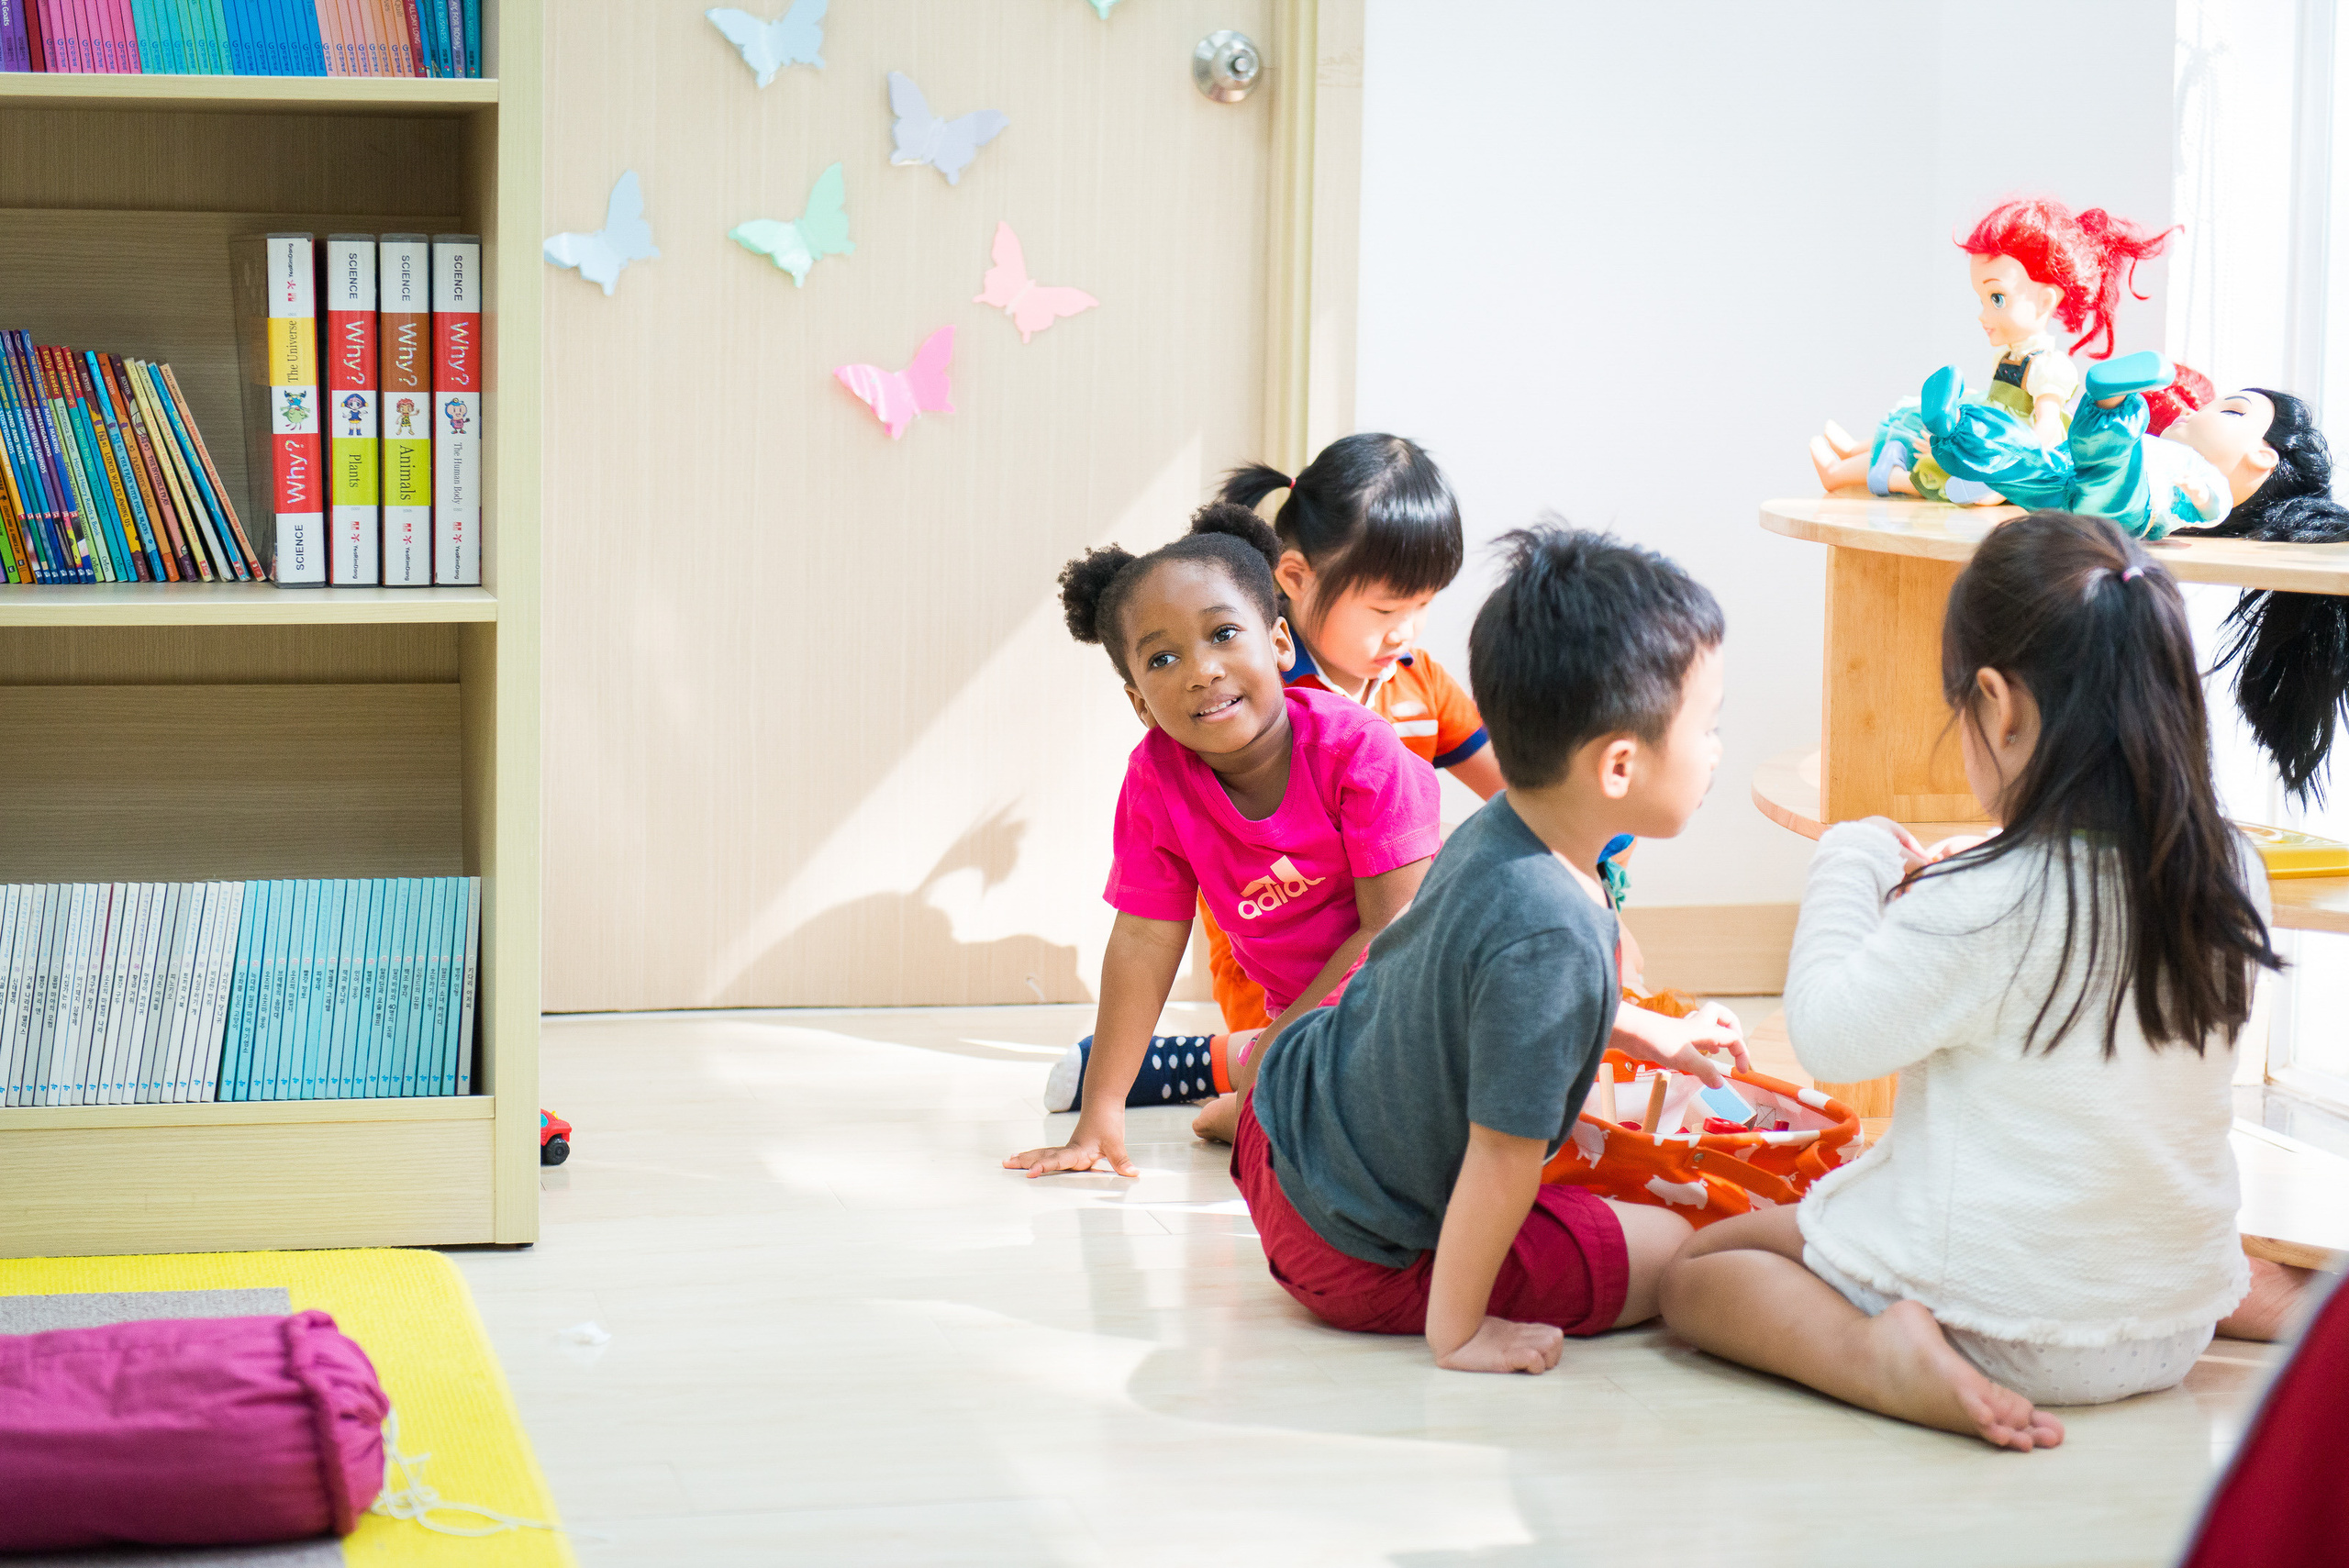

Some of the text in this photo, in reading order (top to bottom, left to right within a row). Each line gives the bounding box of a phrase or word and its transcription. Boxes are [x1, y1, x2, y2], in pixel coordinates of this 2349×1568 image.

[410, 15, 418, 27] DAY
[439, 13, 448, 44] BUSINESS
[413, 28, 421, 44] LONG
[349, 252, 358, 300] SCIENCE
[401, 255, 411, 302] SCIENCE
[454, 255, 463, 302] SCIENCE
[287, 320, 297, 362] Universe
[343, 320, 365, 385] Why?
[395, 322, 417, 386] Why?
[448, 322, 470, 386] Why?
[66, 352, 74, 368] Early
[72, 370, 81, 391] Reader
[82, 373, 92, 392] BENTON
[121, 376, 131, 395] BENTON
[287, 365, 299, 384] The
[13, 367, 21, 383] LITTLE
[25, 409, 33, 430] GAMES
[37, 449, 47, 473] SOUNDS
[35, 408, 52, 457] INVESTIGATIONS
[44, 407, 53, 427] MARK
[50, 428, 61, 454] MAKING
[6, 410, 15, 428] SAND
[11, 428, 19, 442] AND
[16, 444, 26, 465] WATER
[17, 409, 30, 444] PARACHUTE
[27, 445, 35, 461] PLAY
[106, 376, 116, 395] BENTON
[131, 456, 146, 488] FRANTASTIC
[141, 488, 153, 509] VOYAGE
[42, 350, 51, 368] Early
[49, 371, 60, 395] Reader
[59, 406, 70, 434] Francesca
[67, 434, 75, 452] Simon
[72, 458, 83, 478] Horrid
[78, 478, 90, 497] Henry
[84, 497, 95, 516] Reads
[92, 521, 101, 537] Book
[101, 555, 111, 573] Orion
[55, 352, 64, 370] Early
[61, 372, 72, 395] Reader
[92, 479, 102, 498] Vivian
[97, 498, 108, 517] French
[114, 556, 124, 573] Orion
[104, 451, 117, 474] LUNCH
[119, 456, 128, 468] THE
[148, 455, 156, 467] THE
[453, 442, 462, 457] The
[123, 467, 133, 484] FRAN
[150, 466, 165, 492] INVISIBLE
[284, 439, 308, 504] Why?
[349, 453, 362, 488] Plants
[399, 445, 417, 501] Animals
[454, 460, 462, 484] Human
[111, 473, 123, 497] WALKS
[128, 484, 138, 501] WITH
[159, 492, 170, 506] FRAN
[451, 486, 462, 505] Body
[116, 496, 128, 518] AMONG
[133, 501, 143, 516] FOUR
[123, 517, 131, 528] US
[138, 516, 150, 536] BRAINS
[295, 524, 305, 571] SCIENCE
[90, 556, 101, 573] Orion
